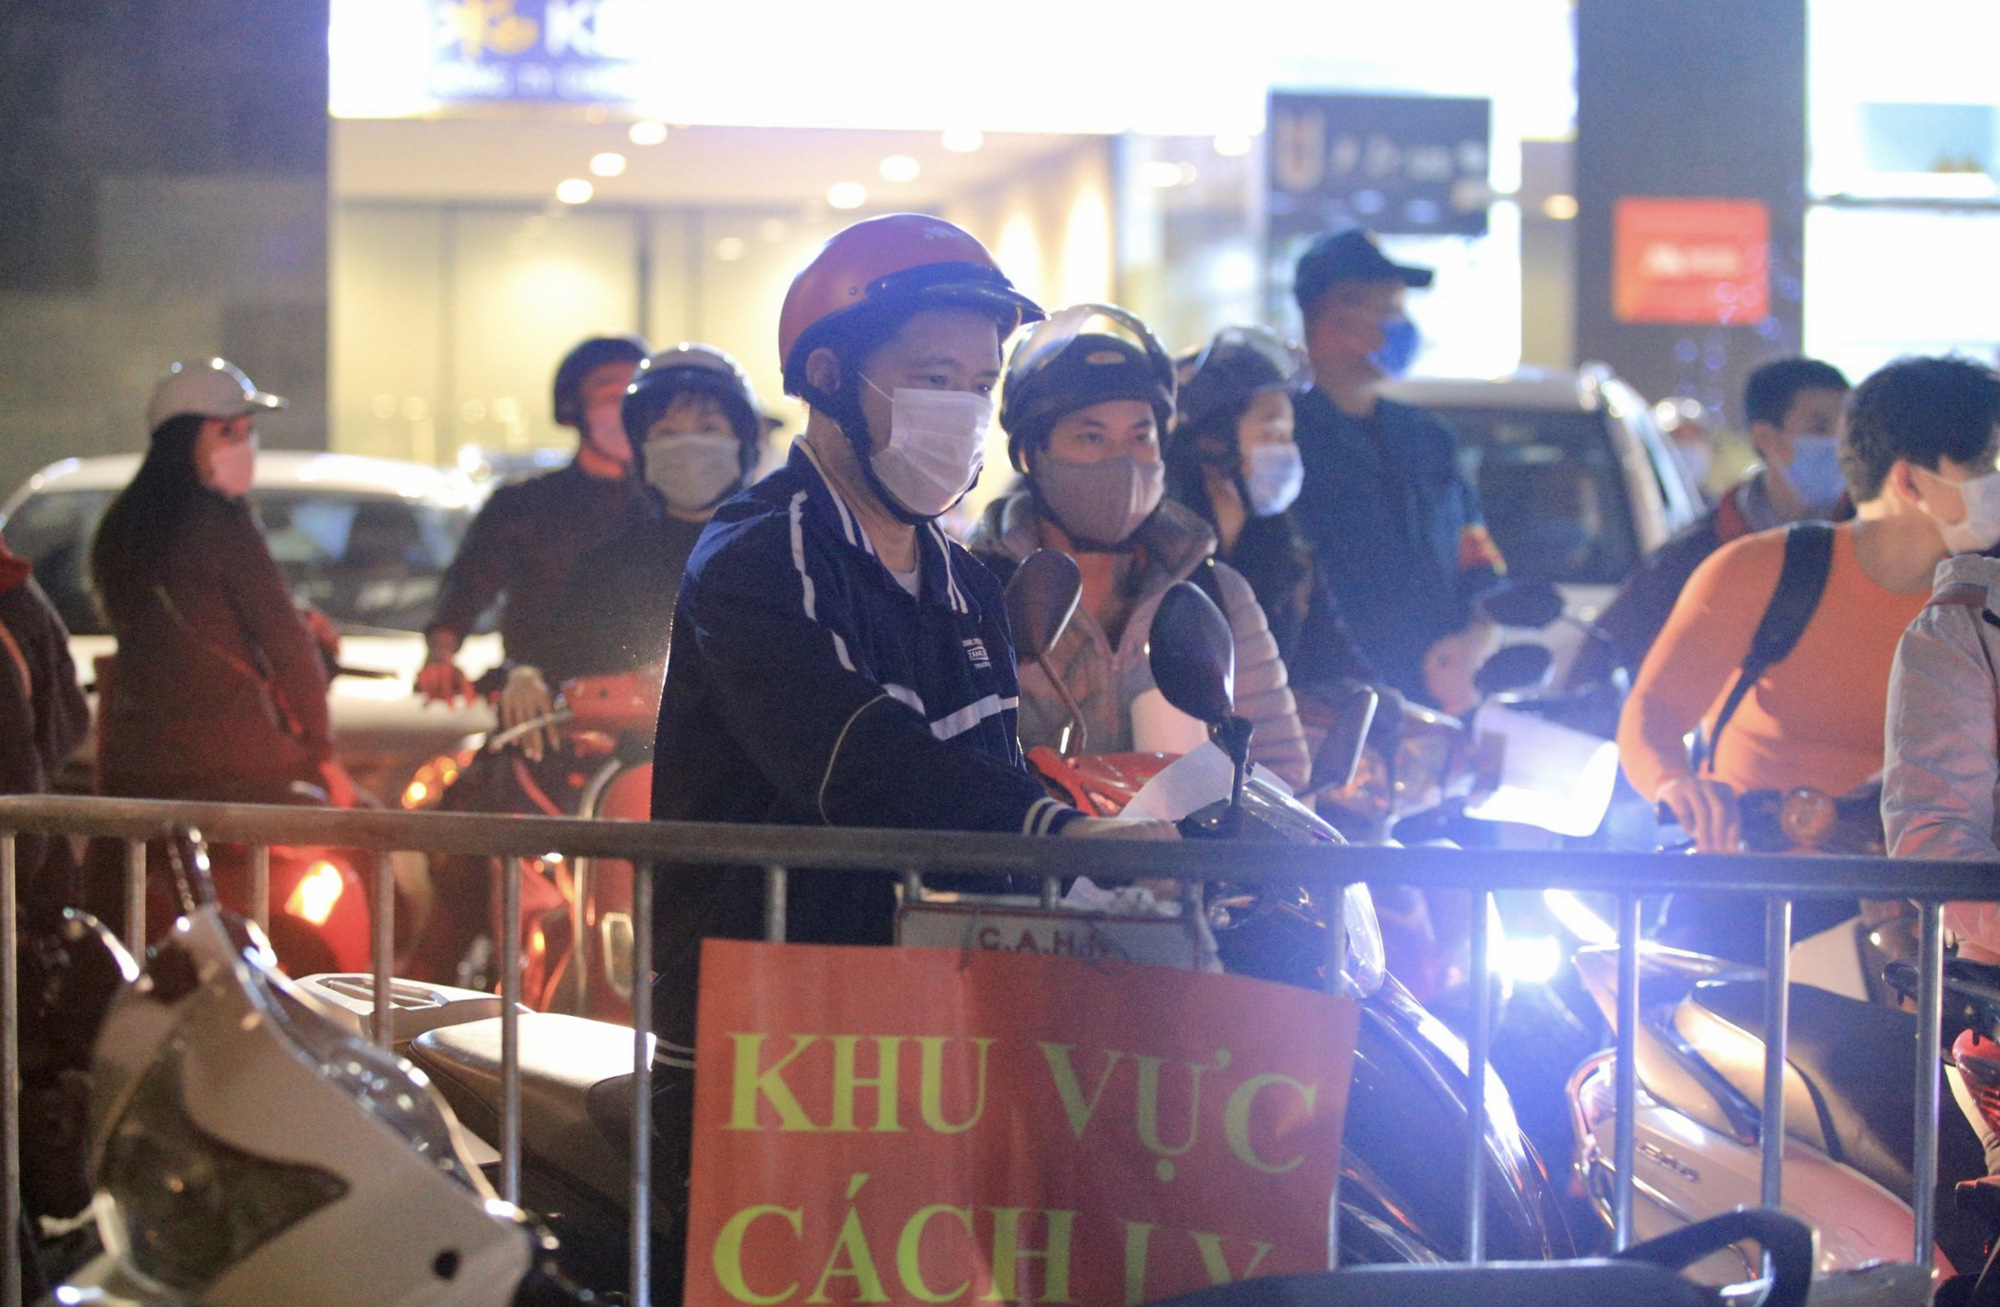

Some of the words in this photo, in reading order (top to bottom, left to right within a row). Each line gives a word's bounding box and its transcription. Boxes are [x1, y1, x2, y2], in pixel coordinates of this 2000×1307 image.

[721, 1033, 997, 1133] KHU
[1038, 1041, 1317, 1181] VỰC
[713, 1173, 1077, 1303] CÁCH
